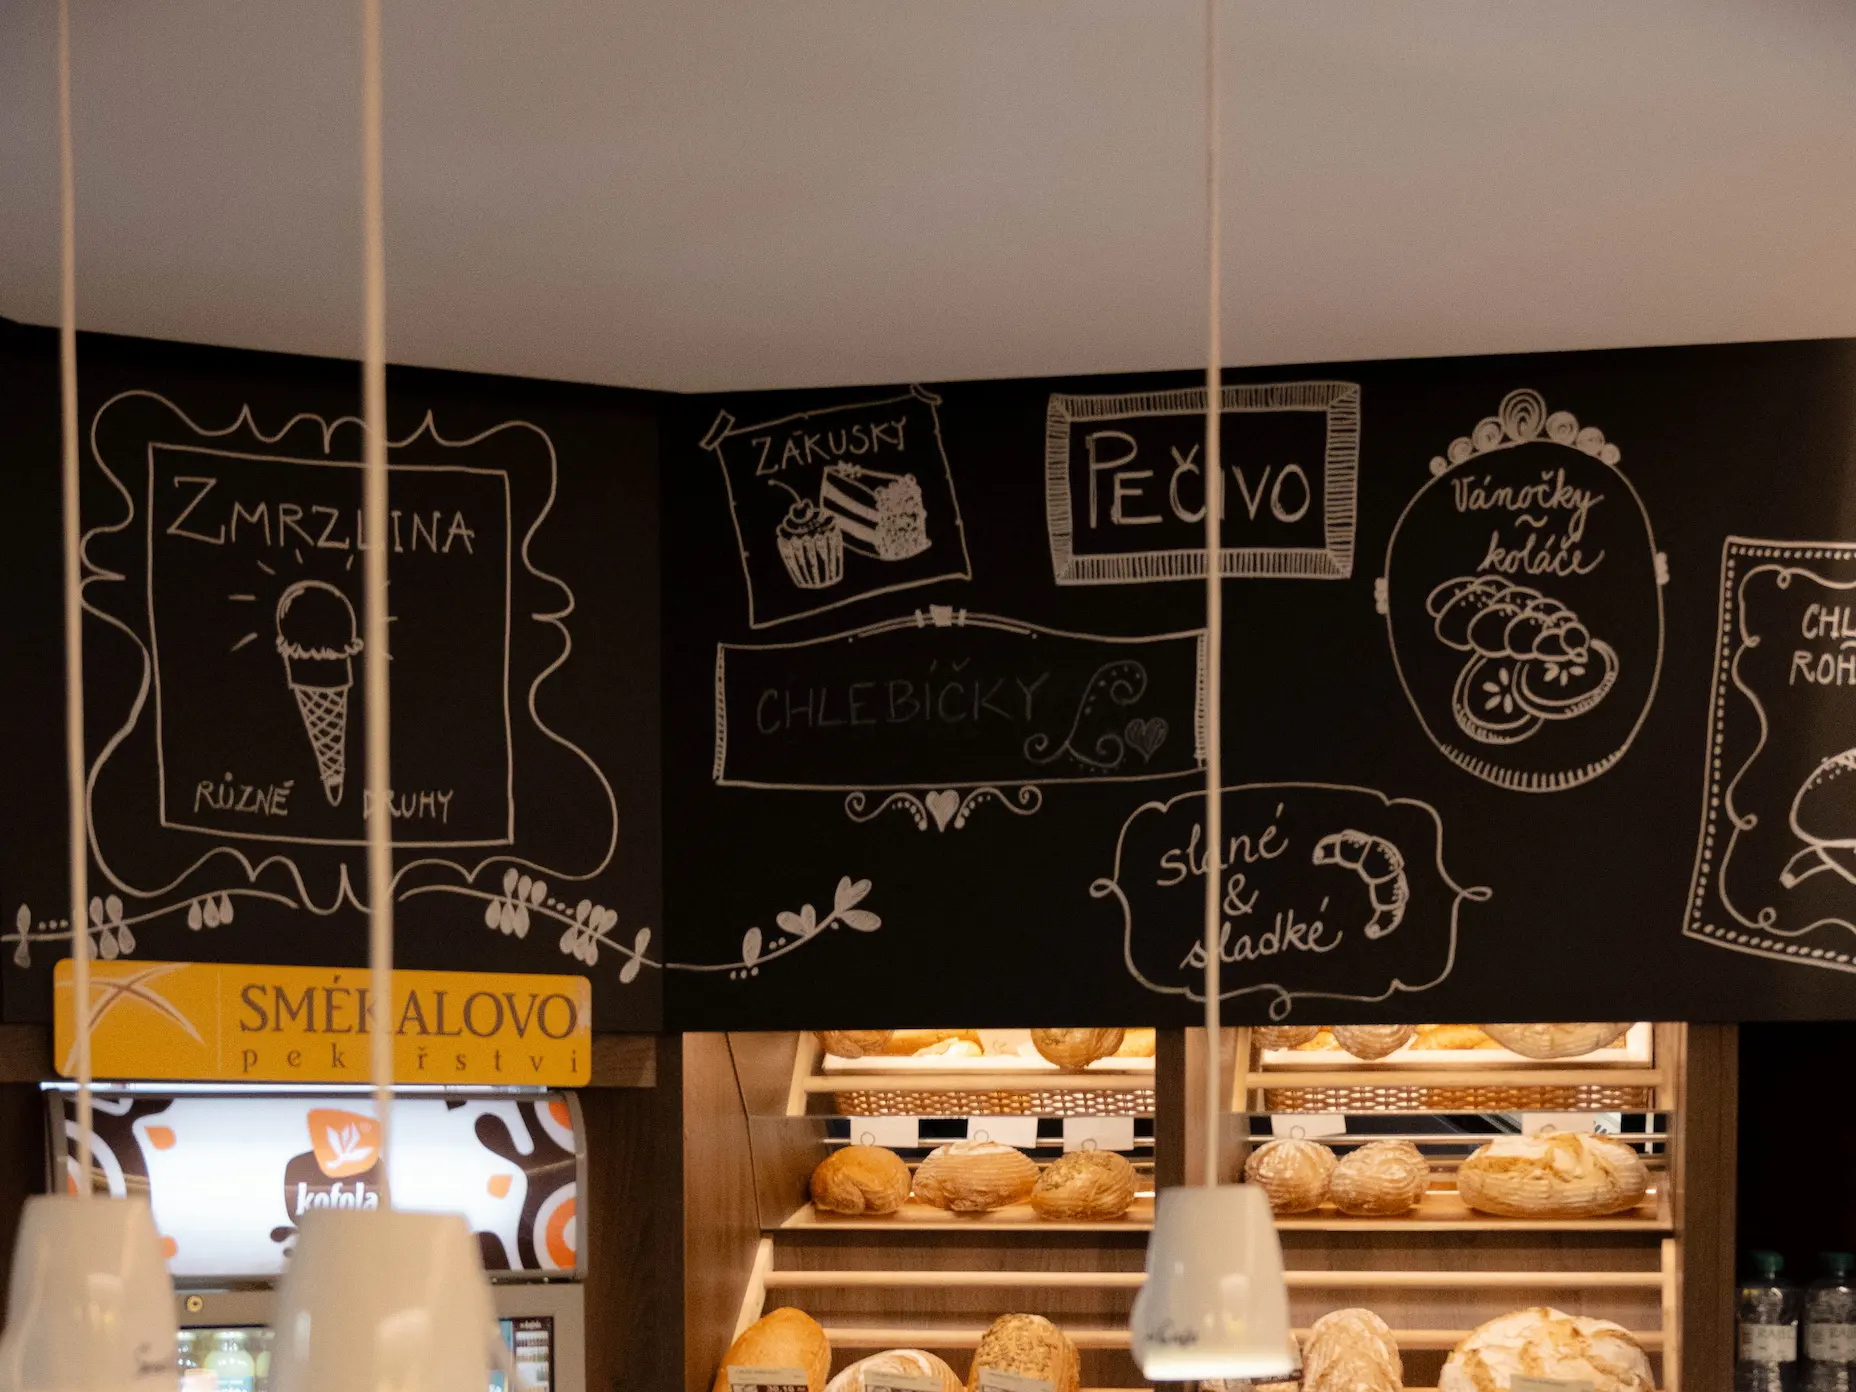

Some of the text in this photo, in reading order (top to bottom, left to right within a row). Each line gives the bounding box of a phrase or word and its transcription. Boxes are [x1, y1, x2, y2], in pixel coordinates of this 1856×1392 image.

[752, 415, 906, 476] ZÁKUSKY
[757, 657, 1050, 735] CHLEBÍČKY
[194, 772, 295, 816] RŮZNÉ
[1223, 873, 1259, 916] &
